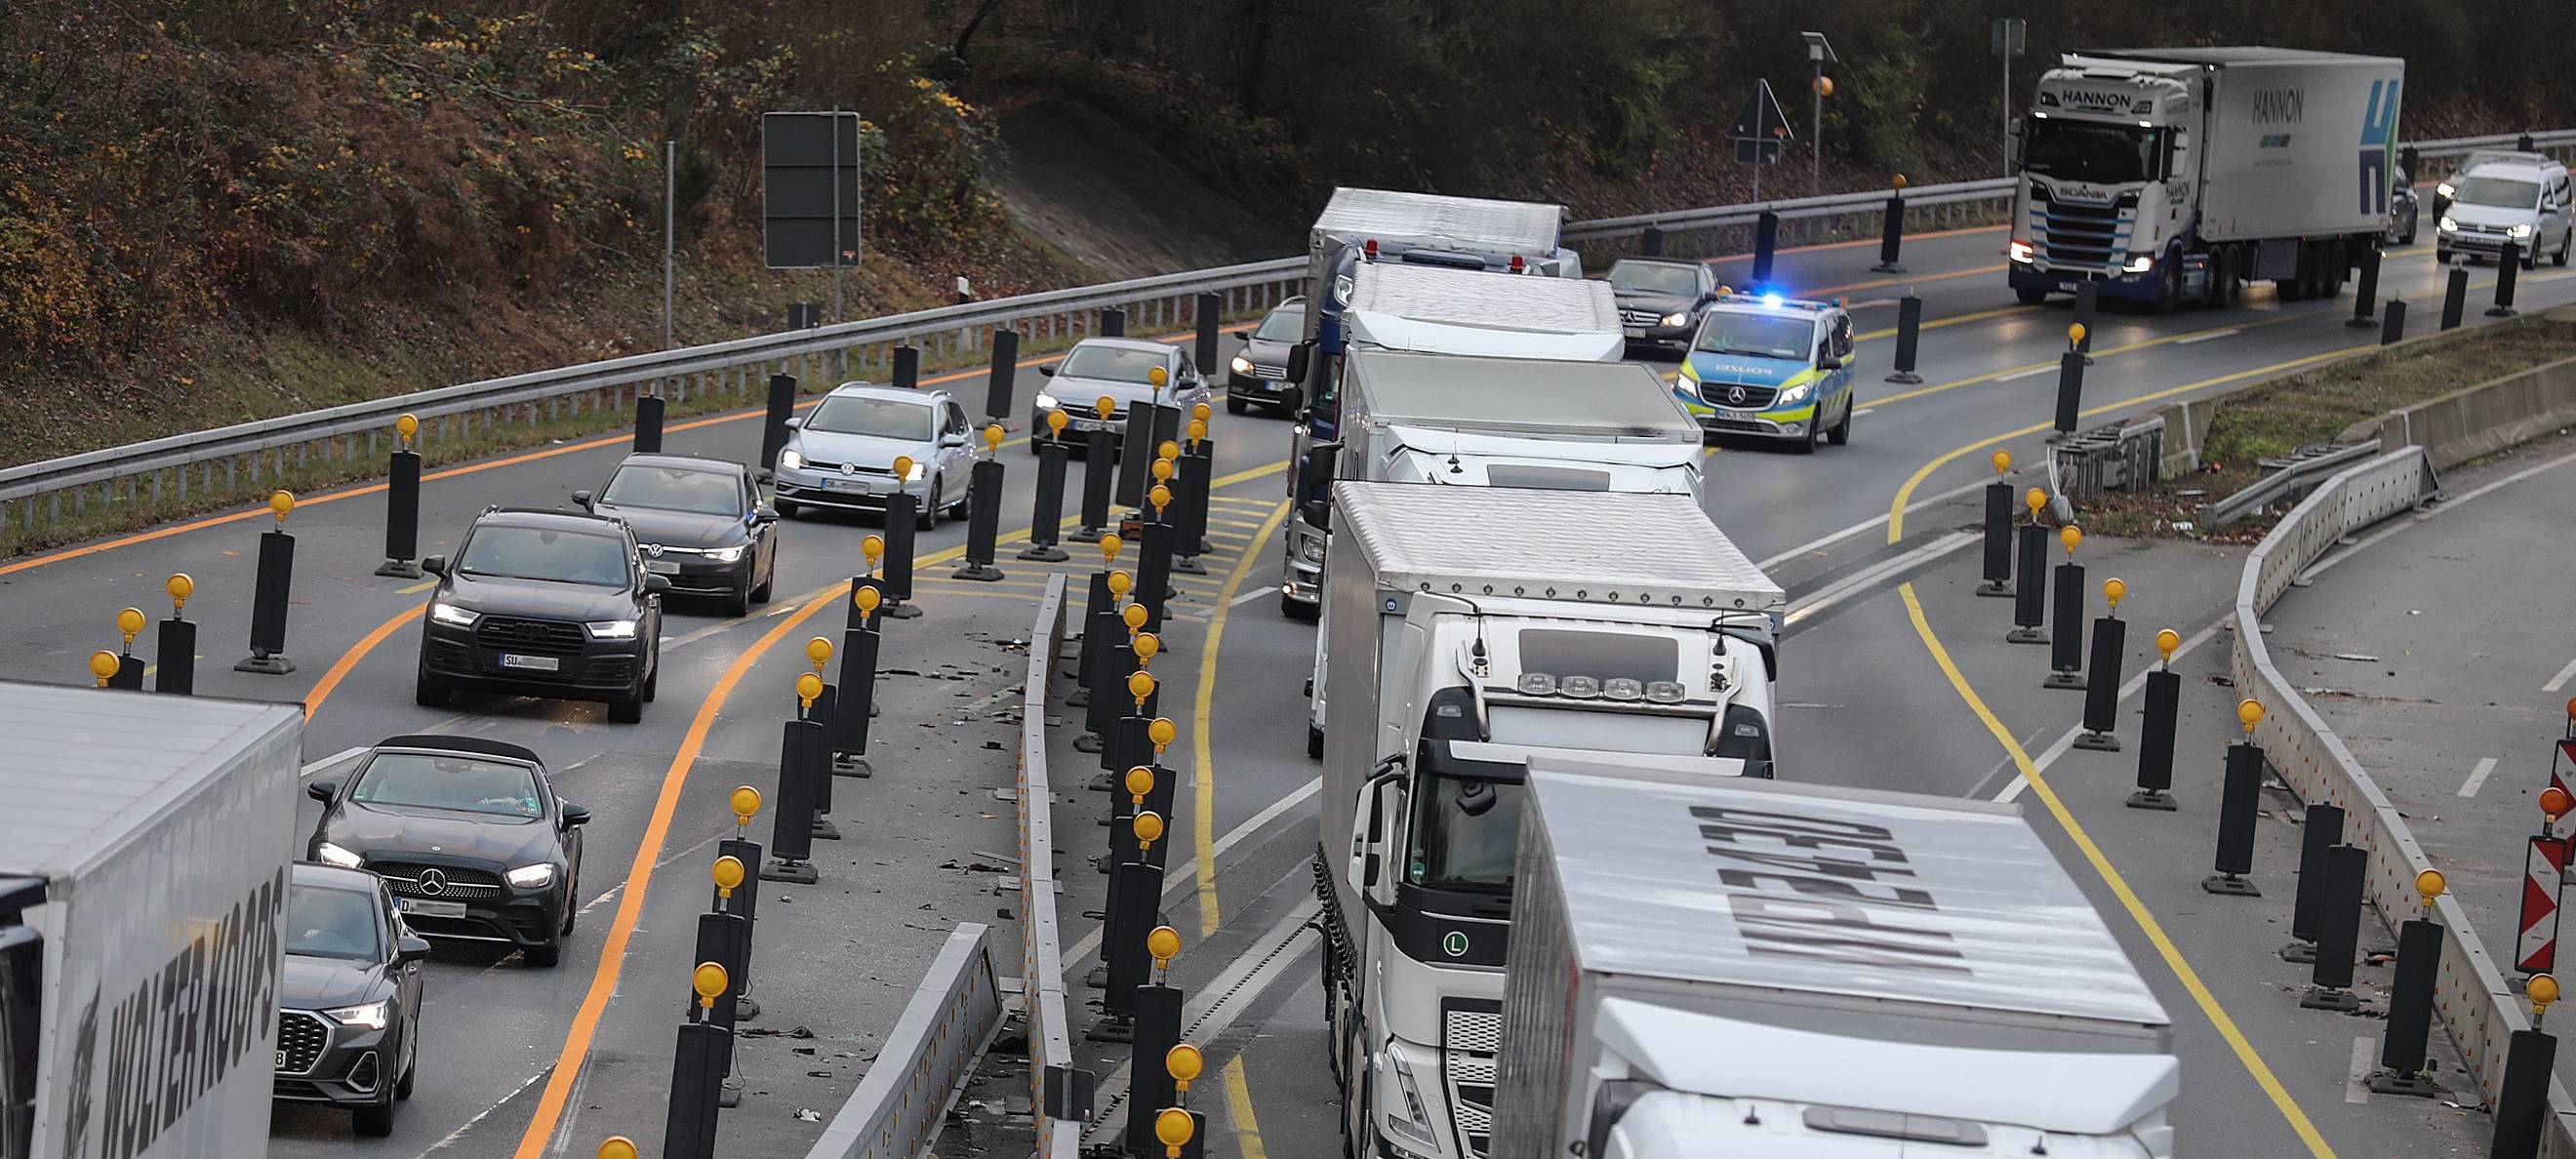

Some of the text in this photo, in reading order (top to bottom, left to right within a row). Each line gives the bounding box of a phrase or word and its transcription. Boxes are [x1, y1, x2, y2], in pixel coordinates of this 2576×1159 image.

[2062, 90, 2131, 108] HANNON
[2252, 87, 2304, 125] HANNON
[2059, 186, 2109, 199] SCANIA
[506, 656, 518, 665] SU
[402, 899, 410, 912] D
[1451, 936, 1462, 951] L
[101, 865, 284, 1159] WOLTER KOOPS
